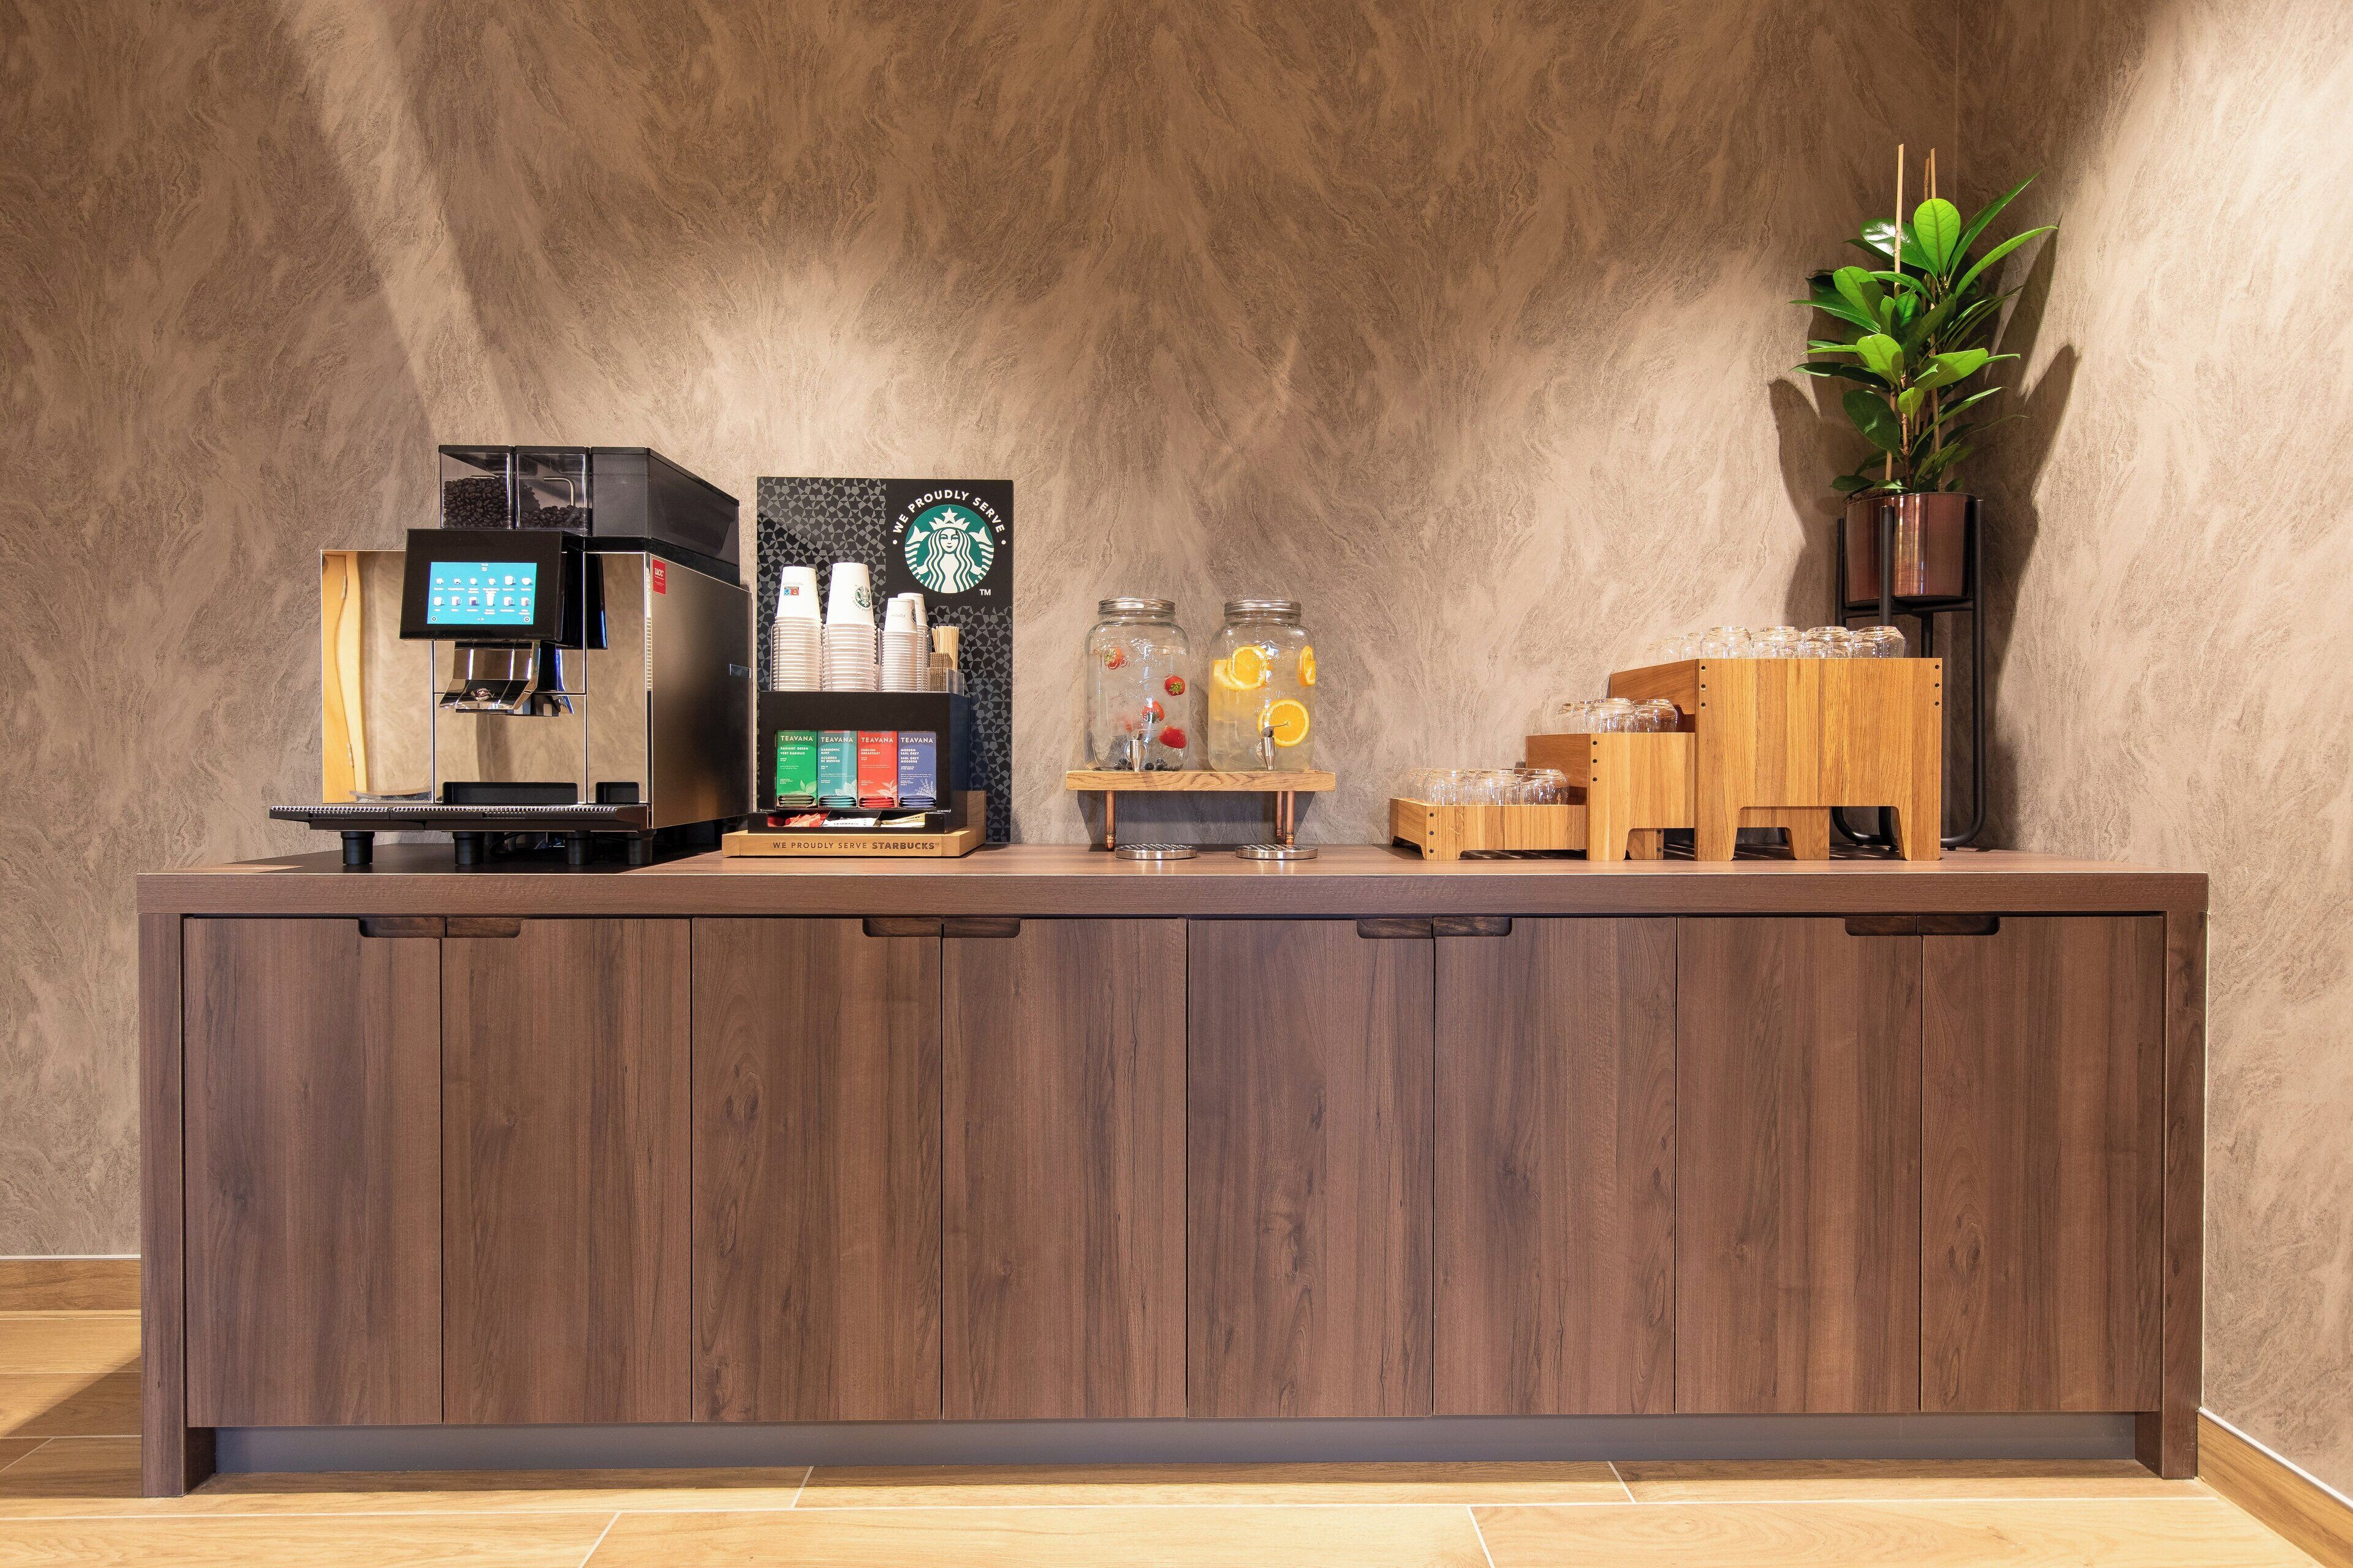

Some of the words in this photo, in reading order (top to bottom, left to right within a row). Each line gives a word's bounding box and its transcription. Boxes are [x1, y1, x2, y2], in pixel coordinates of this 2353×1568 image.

[892, 513, 909, 534] WE
[907, 490, 970, 513] PROUDLY
[972, 497, 1006, 534] SERVE
